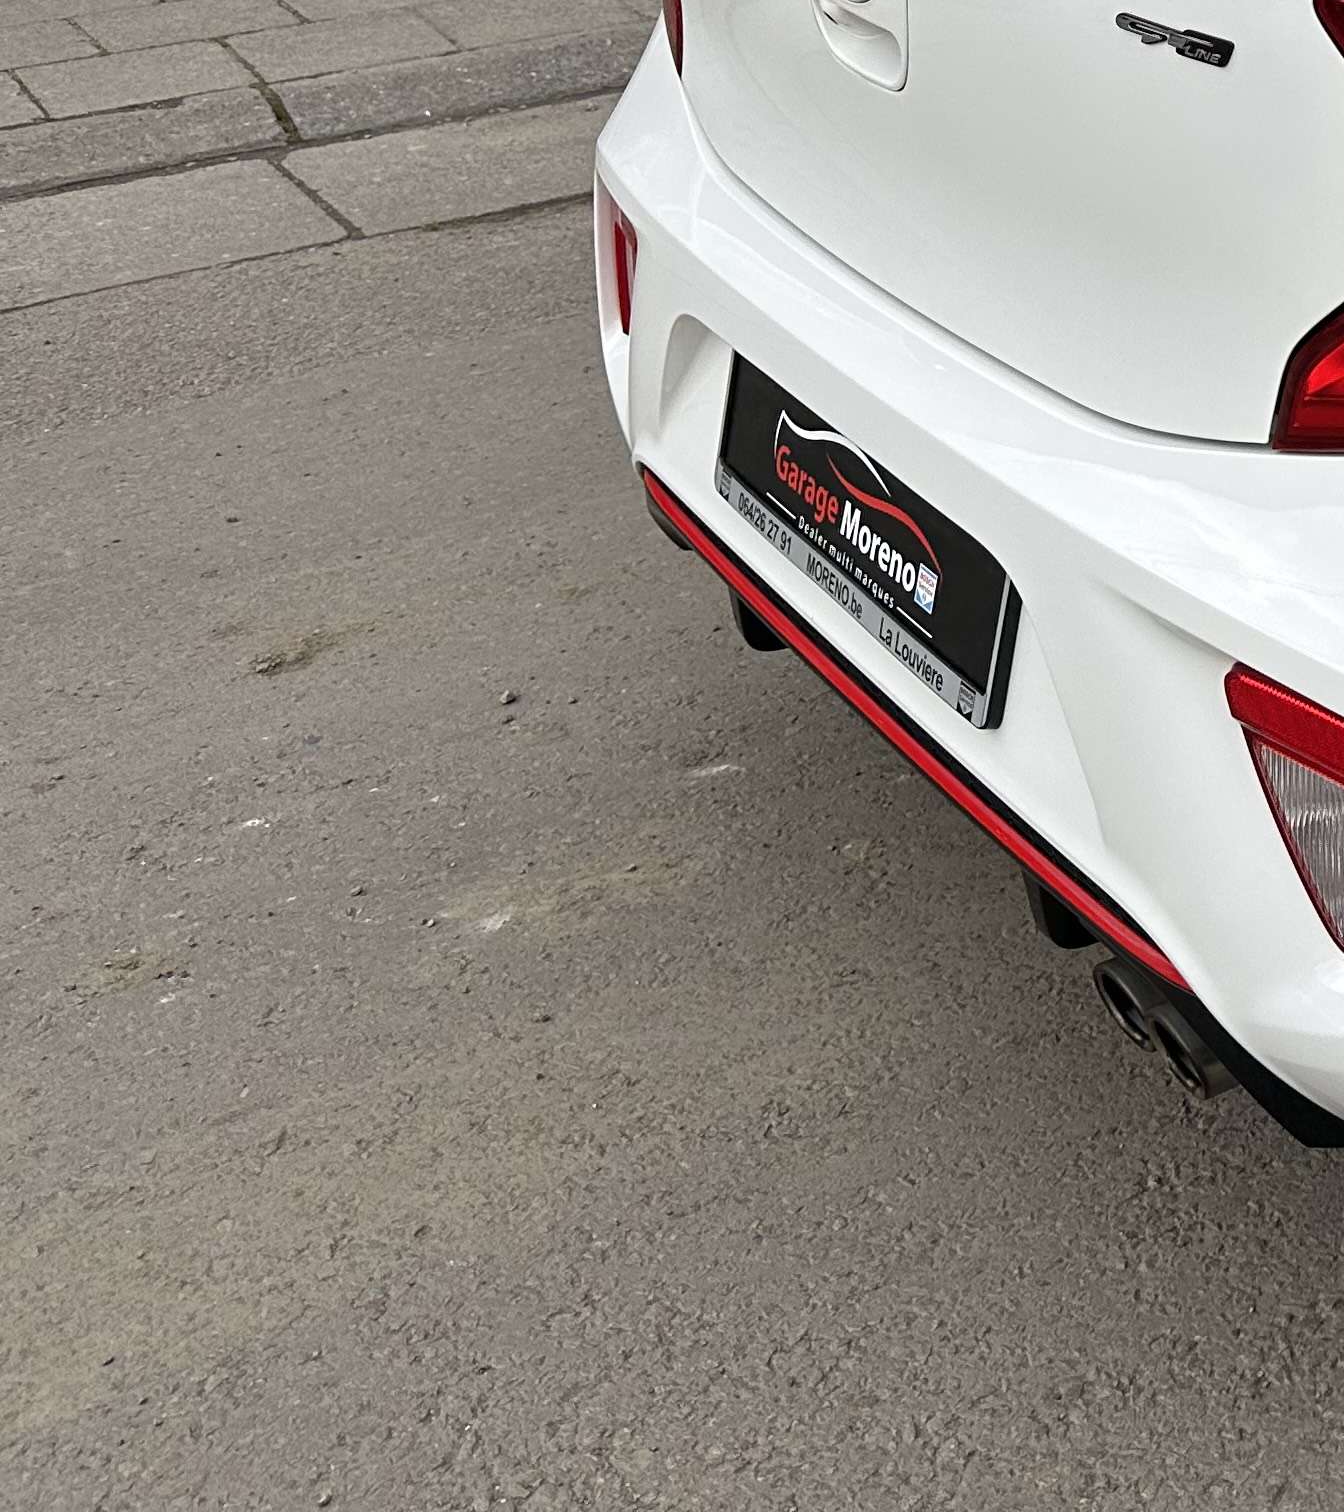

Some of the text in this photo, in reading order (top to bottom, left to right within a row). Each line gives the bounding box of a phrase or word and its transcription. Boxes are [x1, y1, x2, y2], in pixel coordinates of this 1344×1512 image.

[1184, 45, 1222, 65] LINE
[775, 445, 917, 592] Garage Moreno
[798, 515, 895, 609] Dealer multi marques
[738, 492, 944, 692] 064/26 27 91 MORENO.be La Louviere
